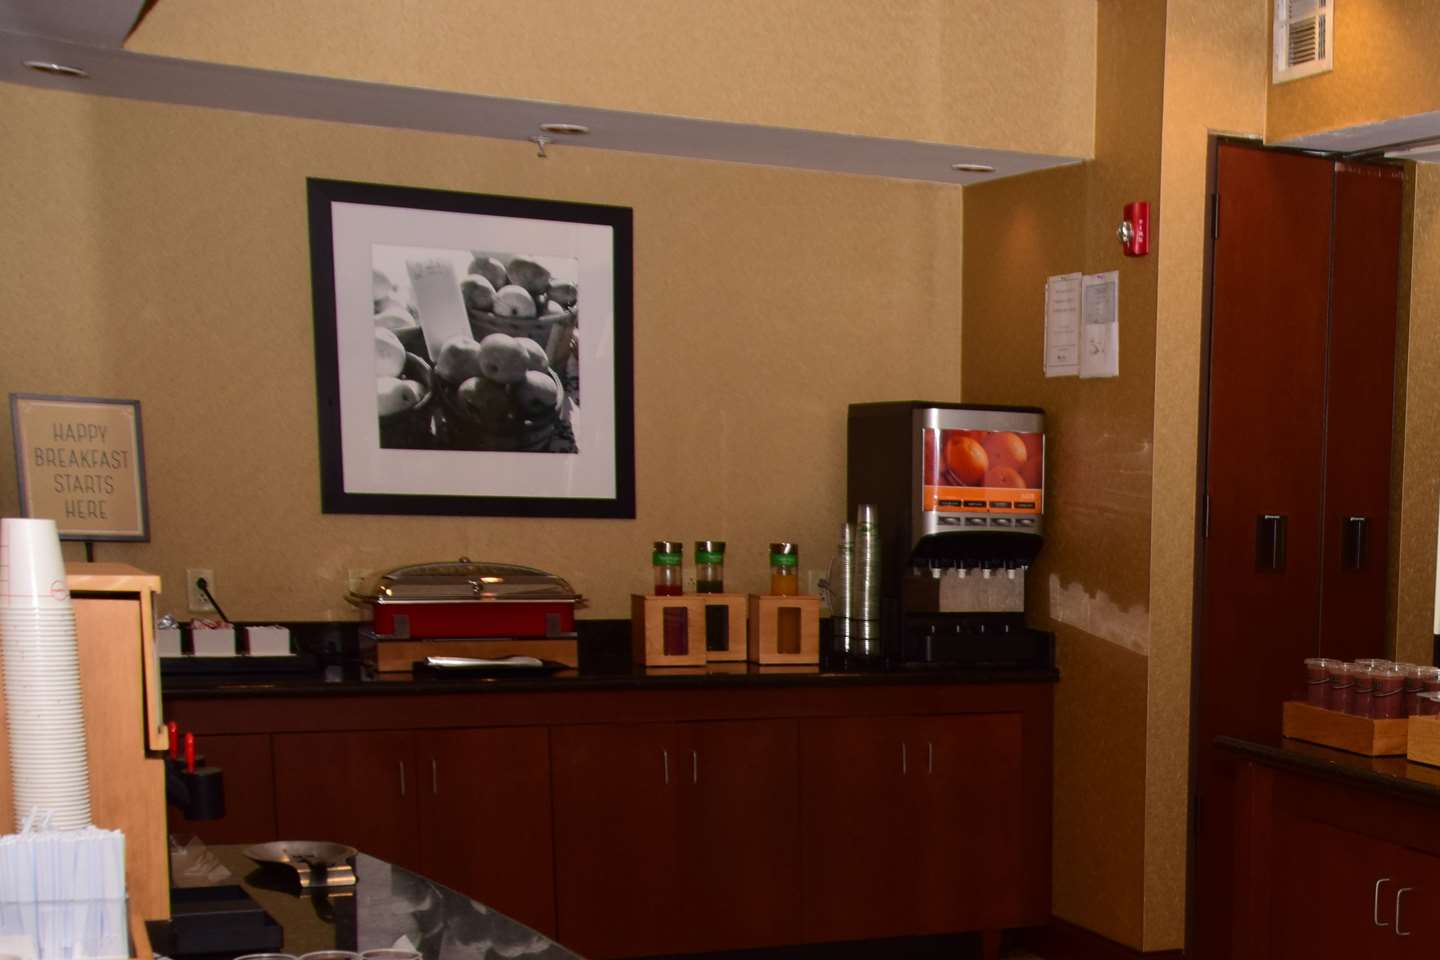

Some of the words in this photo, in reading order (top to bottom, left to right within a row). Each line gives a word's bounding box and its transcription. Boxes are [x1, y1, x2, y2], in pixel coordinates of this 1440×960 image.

[53, 423, 108, 443] HAPPY
[34, 448, 129, 470] BREAKFAST
[54, 474, 114, 495] STARTS
[65, 500, 108, 520] HERE
